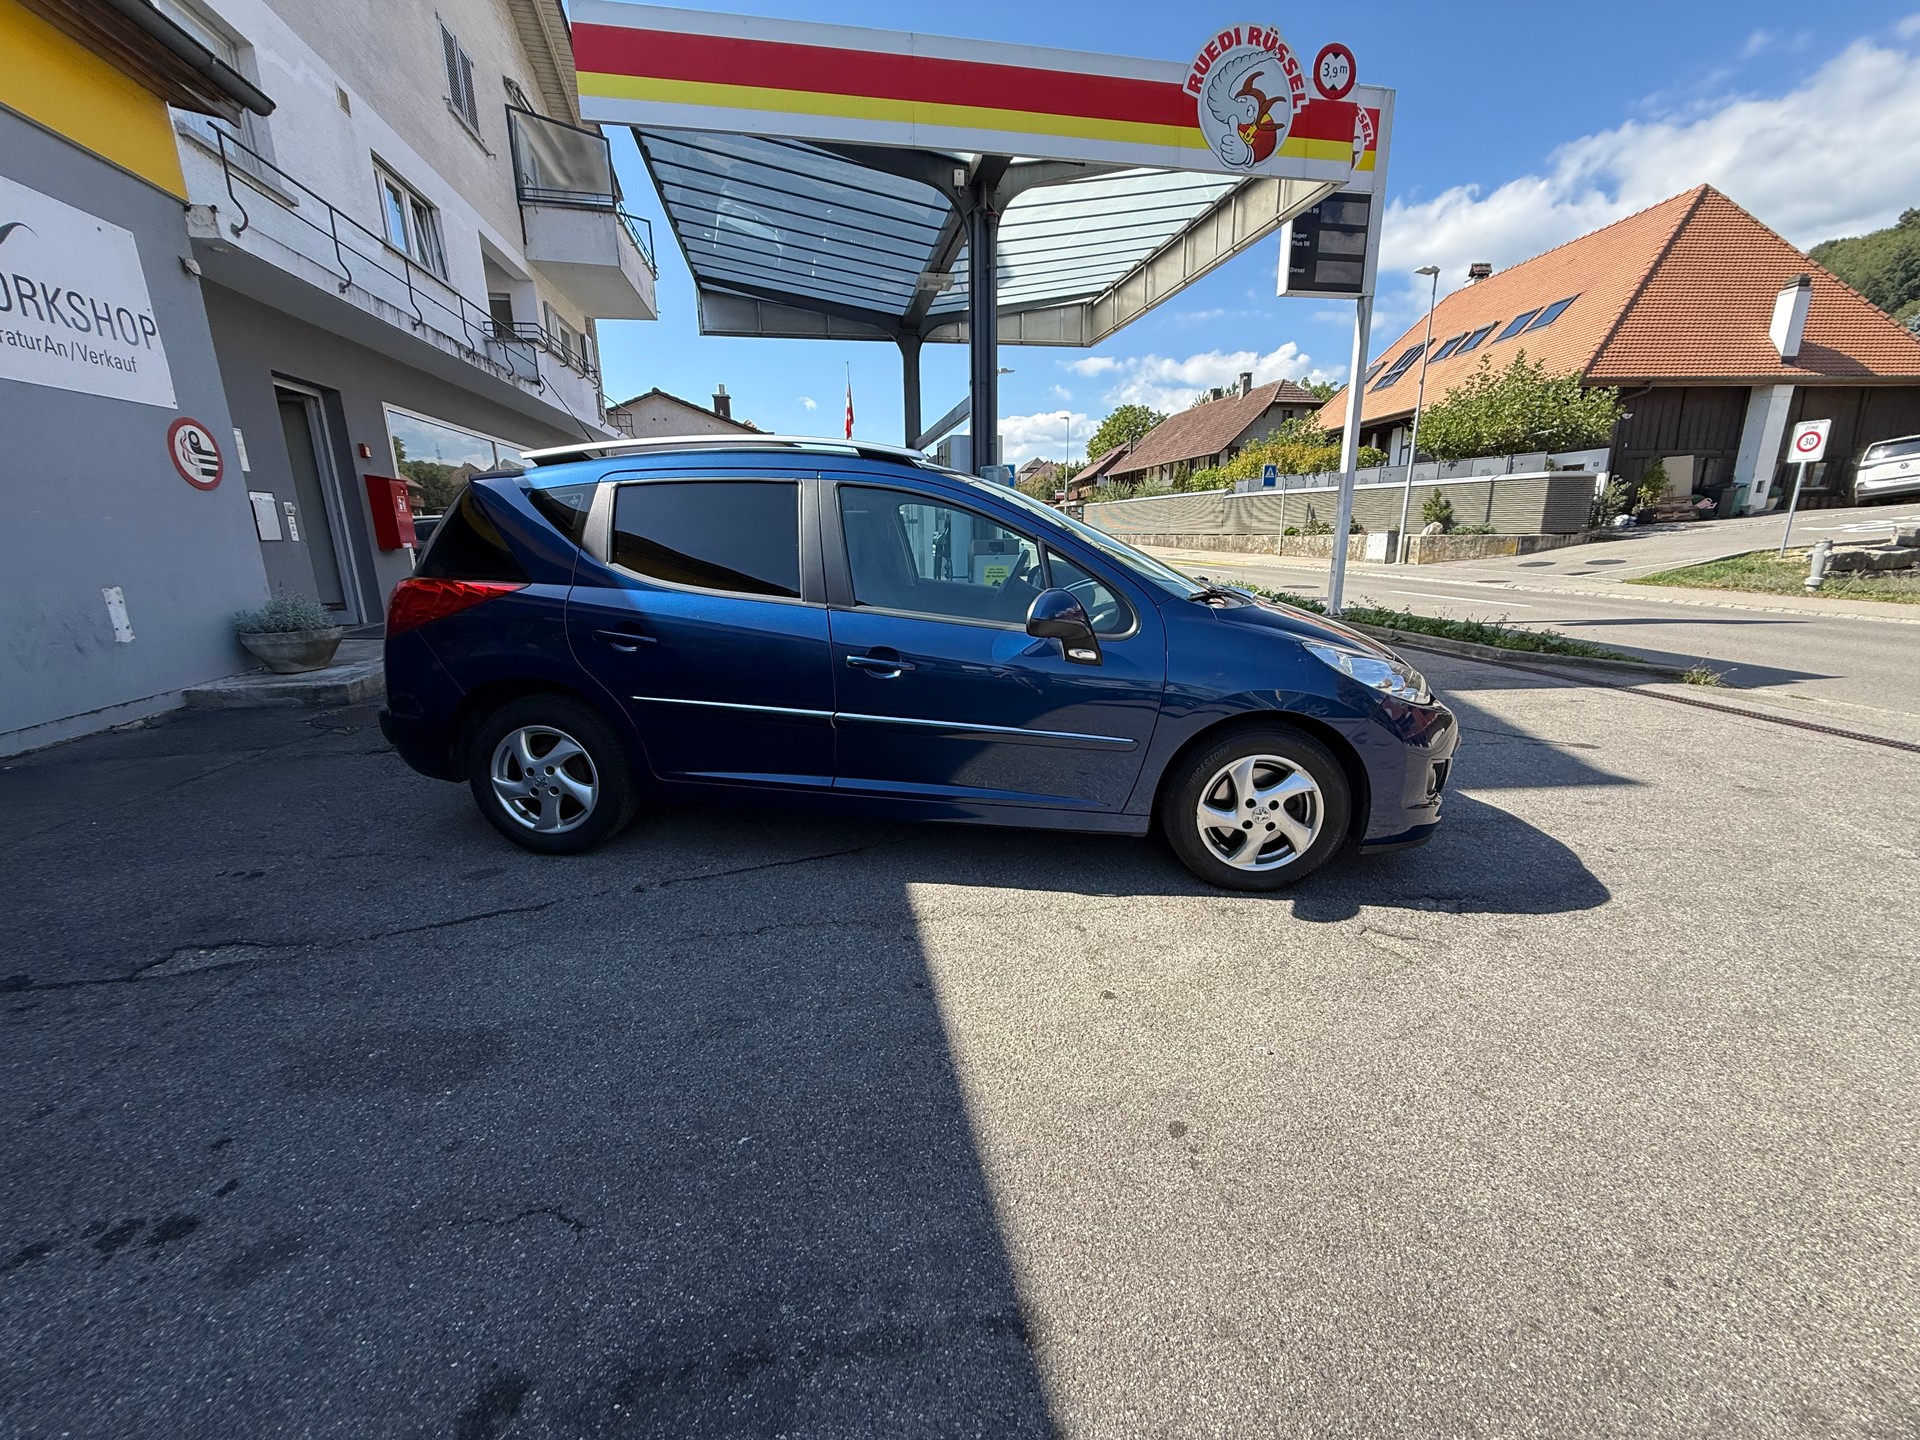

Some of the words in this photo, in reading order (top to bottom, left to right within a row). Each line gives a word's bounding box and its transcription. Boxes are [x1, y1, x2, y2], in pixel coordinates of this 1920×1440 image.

[1187, 27, 1241, 94] RUEDI
[1247, 26, 1306, 109] RÜSSEL
[1292, 231, 1308, 240] Super
[1289, 266, 1306, 274] Diesel
[1803, 437, 1815, 446] 30
